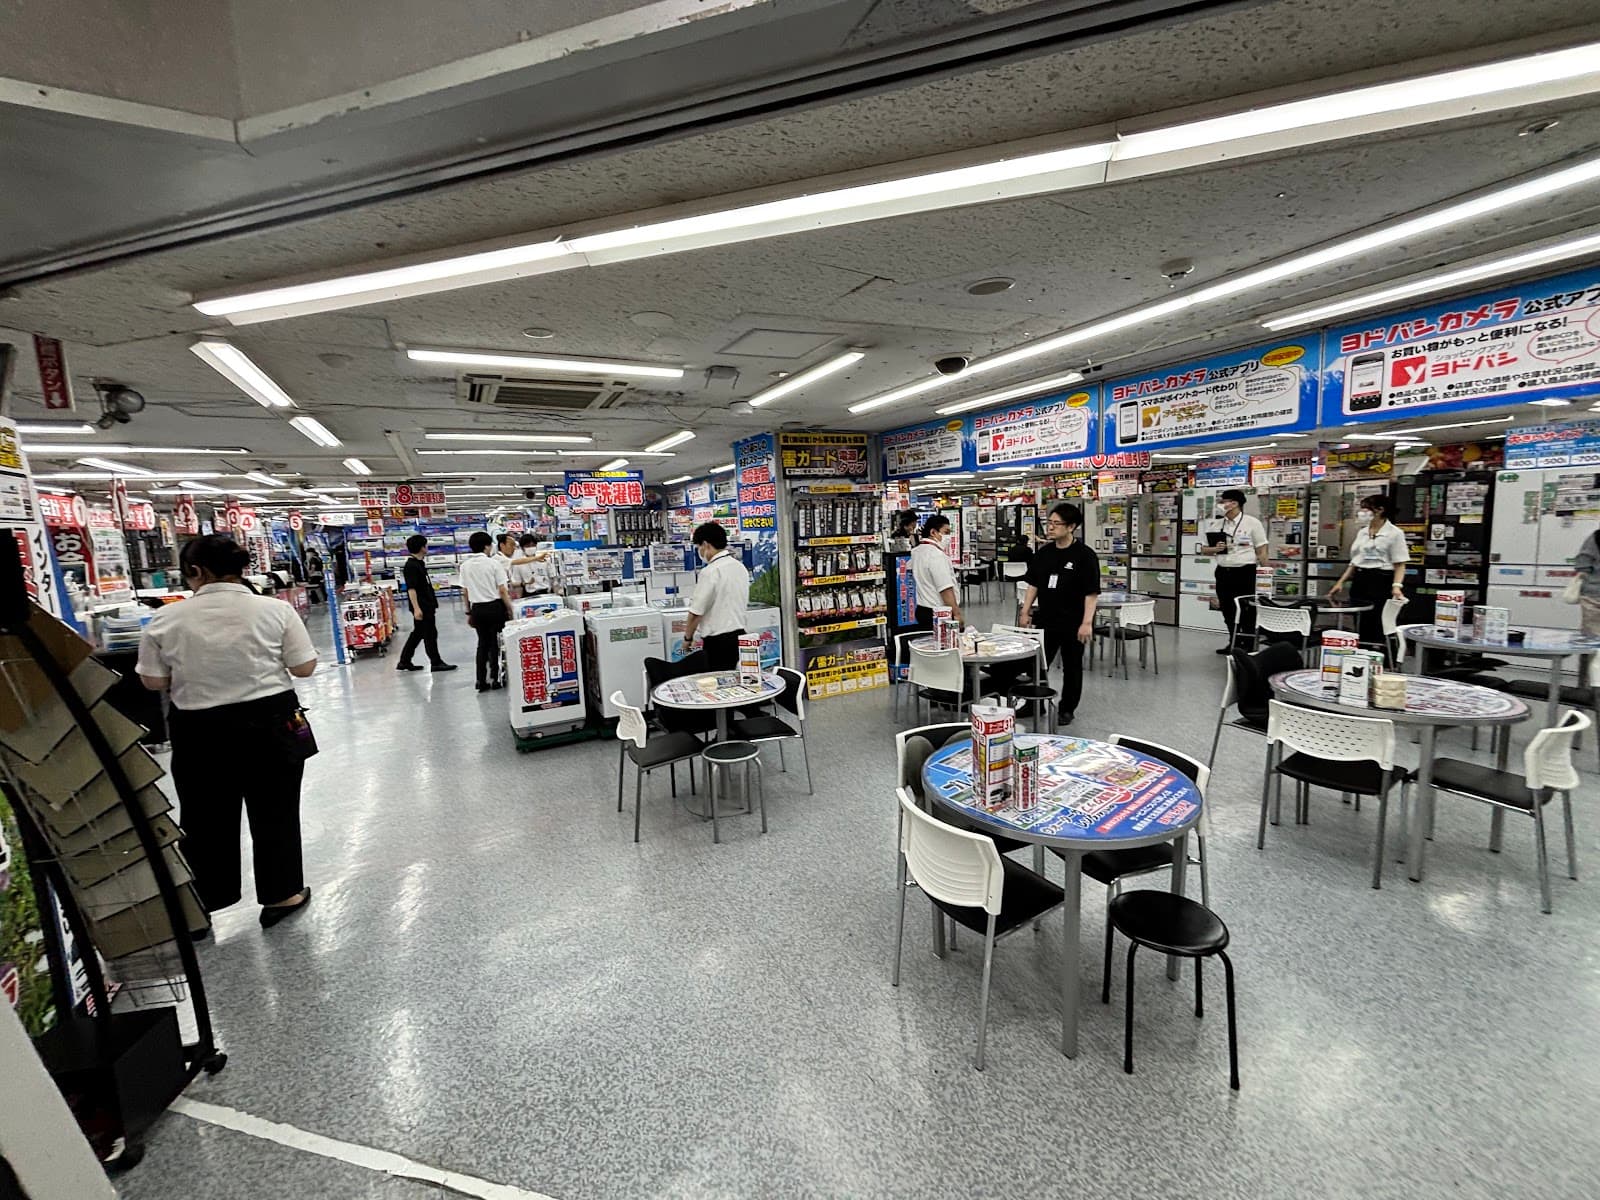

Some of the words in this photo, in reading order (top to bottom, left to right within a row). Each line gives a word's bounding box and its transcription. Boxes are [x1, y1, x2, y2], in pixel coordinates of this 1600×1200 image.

[1342, 298, 1520, 352] ヨドバシカメラ
[1431, 351, 1518, 377] ヨドバシ
[1113, 368, 1207, 400] ヨドバシカメラ
[1209, 361, 1260, 380] 公式アプリ
[976, 407, 1034, 429] ヨドバシカメラ
[568, 480, 643, 506] 小型洗濯機
[343, 609, 376, 622] 便利
[519, 635, 548, 704] 送料無料
[816, 653, 855, 669] 雷ガード
